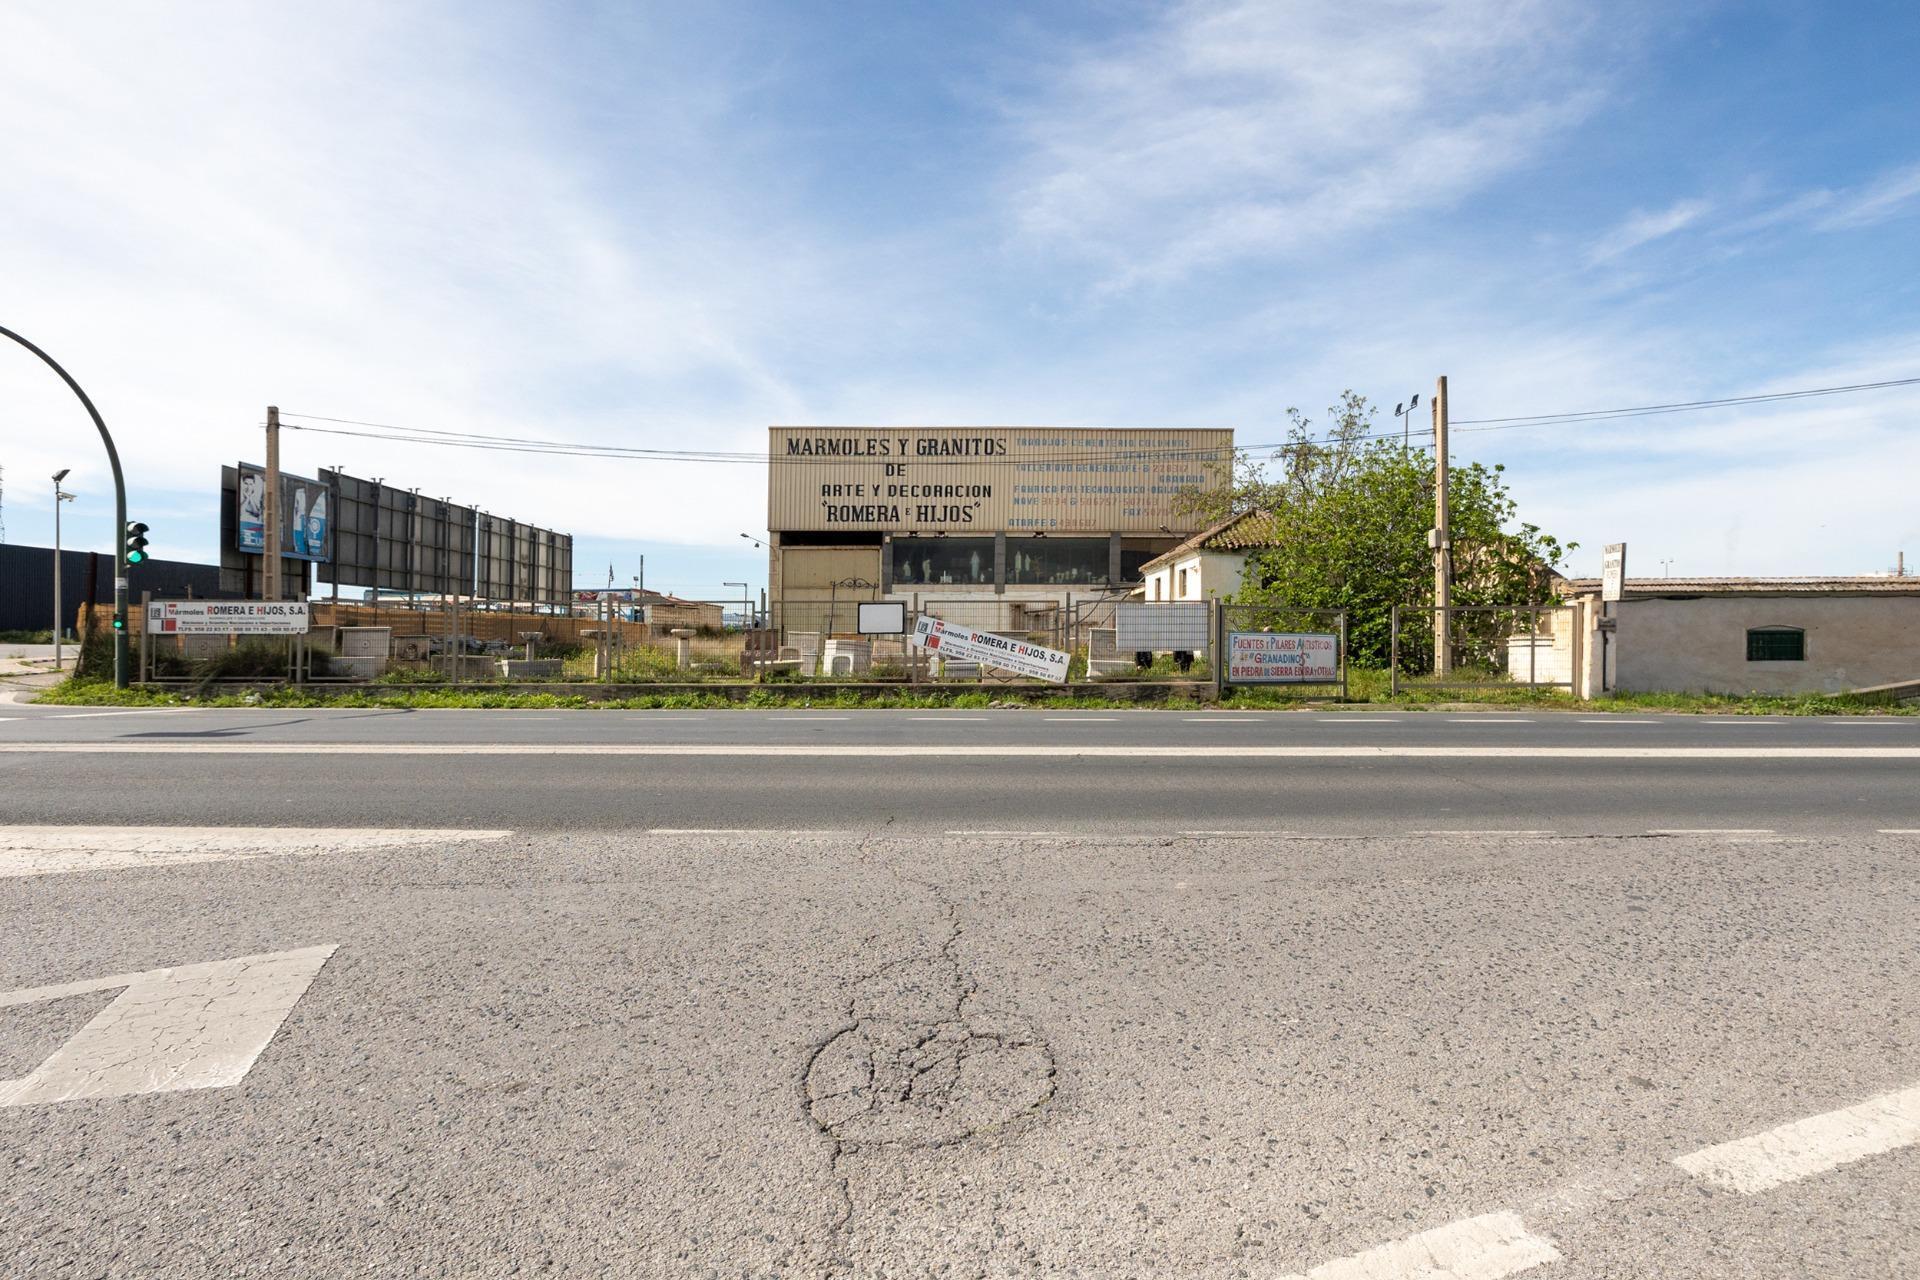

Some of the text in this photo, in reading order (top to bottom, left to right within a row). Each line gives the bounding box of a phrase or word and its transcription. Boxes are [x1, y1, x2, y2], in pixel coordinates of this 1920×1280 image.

[787, 438, 1007, 456] MARMOLES Y GRANITOS
[1072, 438, 1133, 447] CEMENTERIO
[1139, 439, 1190, 448] COLUMNAS
[885, 464, 906, 476] DE
[1016, 464, 1052, 472] TALLER
[1076, 464, 1138, 472] GENERALIFE
[1160, 475, 1204, 484] GRANADA
[822, 484, 992, 498] ARTE Y DECORACION
[1014, 485, 1058, 494] FABRICA
[1014, 497, 1040, 506] NAVE
[905, 507, 911, 516] E
[1122, 508, 1140, 516] FAX
[1008, 518, 1047, 527] ATARFE
[207, 606, 246, 615] ROMERA
[248, 606, 254, 615] E
[256, 606, 287, 616] HIJOS,
[289, 606, 306, 615] S.A.
[970, 632, 1008, 650] ROMERA
[1010, 642, 1016, 652] E
[1018, 644, 1047, 661] HIJOS,
[1232, 636, 1332, 650] FUENTES Y PILARES ARTISTICOS
[1232, 666, 1240, 676] EN
[1241, 666, 1264, 676] PIEDRA
[1270, 666, 1293, 676] SIERRA
[1318, 666, 1335, 676] OTRAS
